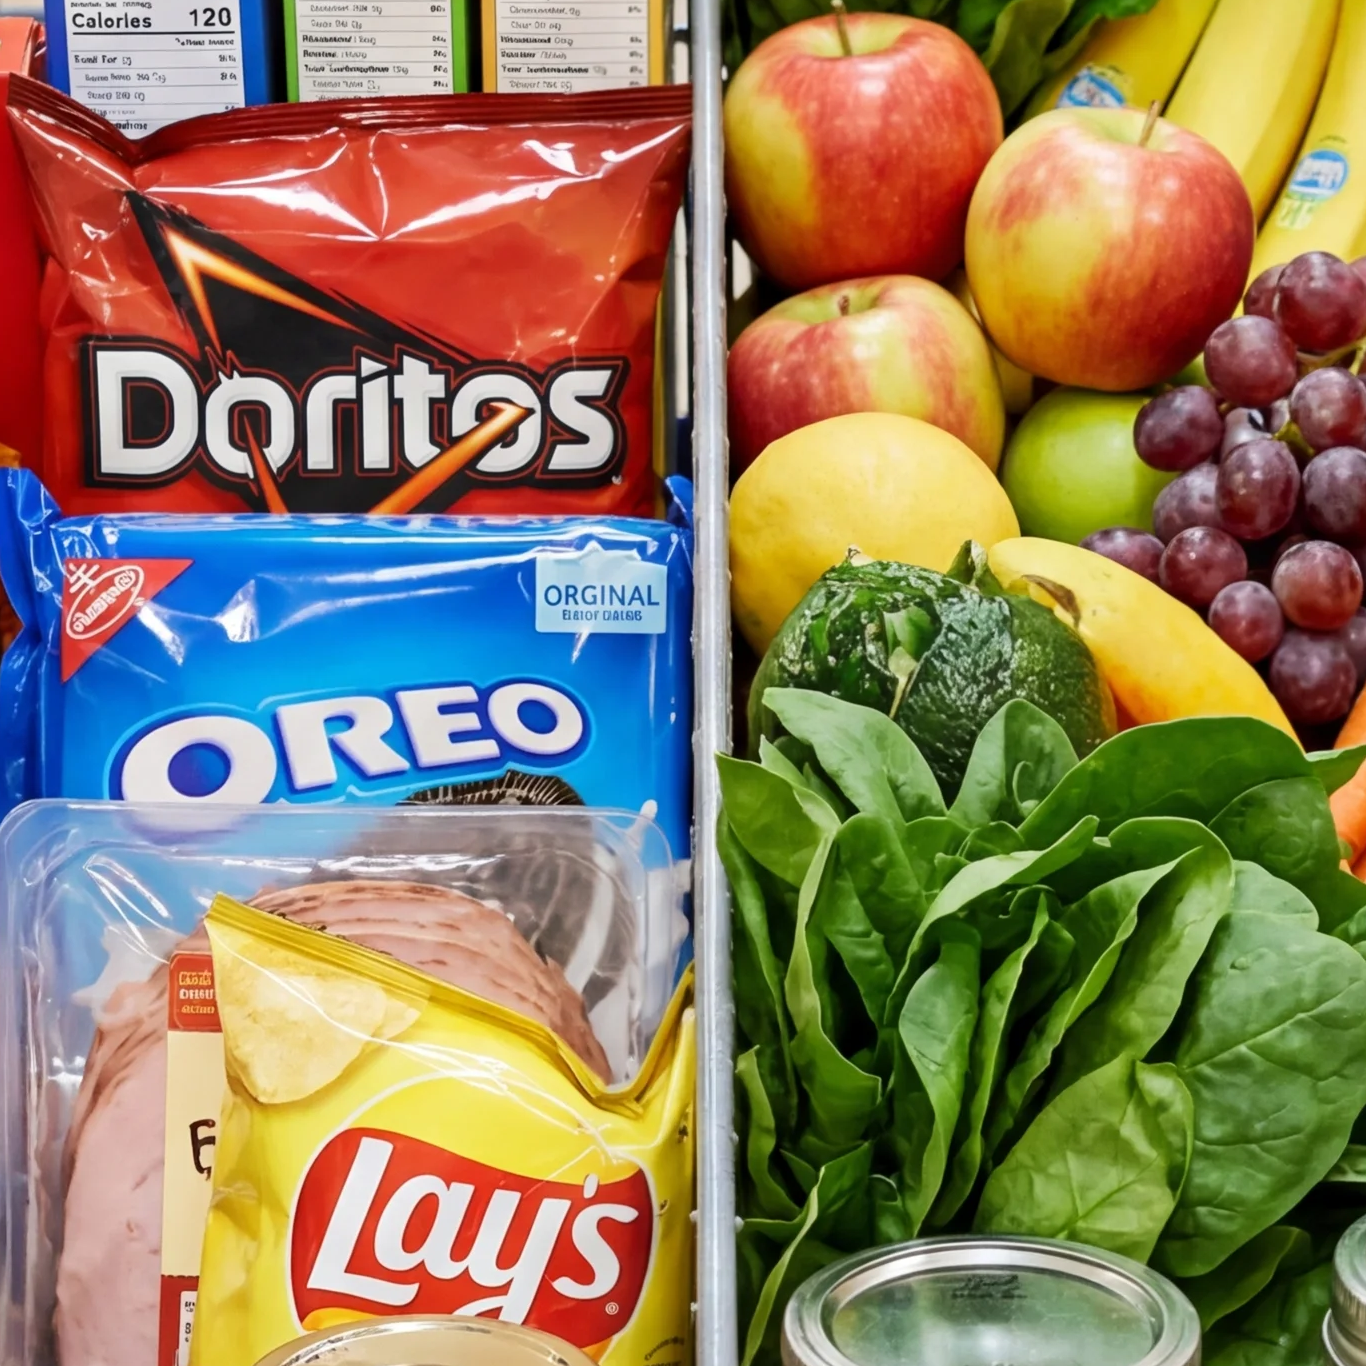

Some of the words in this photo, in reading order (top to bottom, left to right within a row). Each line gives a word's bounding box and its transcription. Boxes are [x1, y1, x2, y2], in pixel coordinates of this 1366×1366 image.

[189, 6, 233, 28] 120
[95, 348, 614, 479] Doritos
[543, 583, 660, 607] ORGINAL
[121, 681, 584, 838] OREO
[306, 1136, 640, 1323] Lay's
